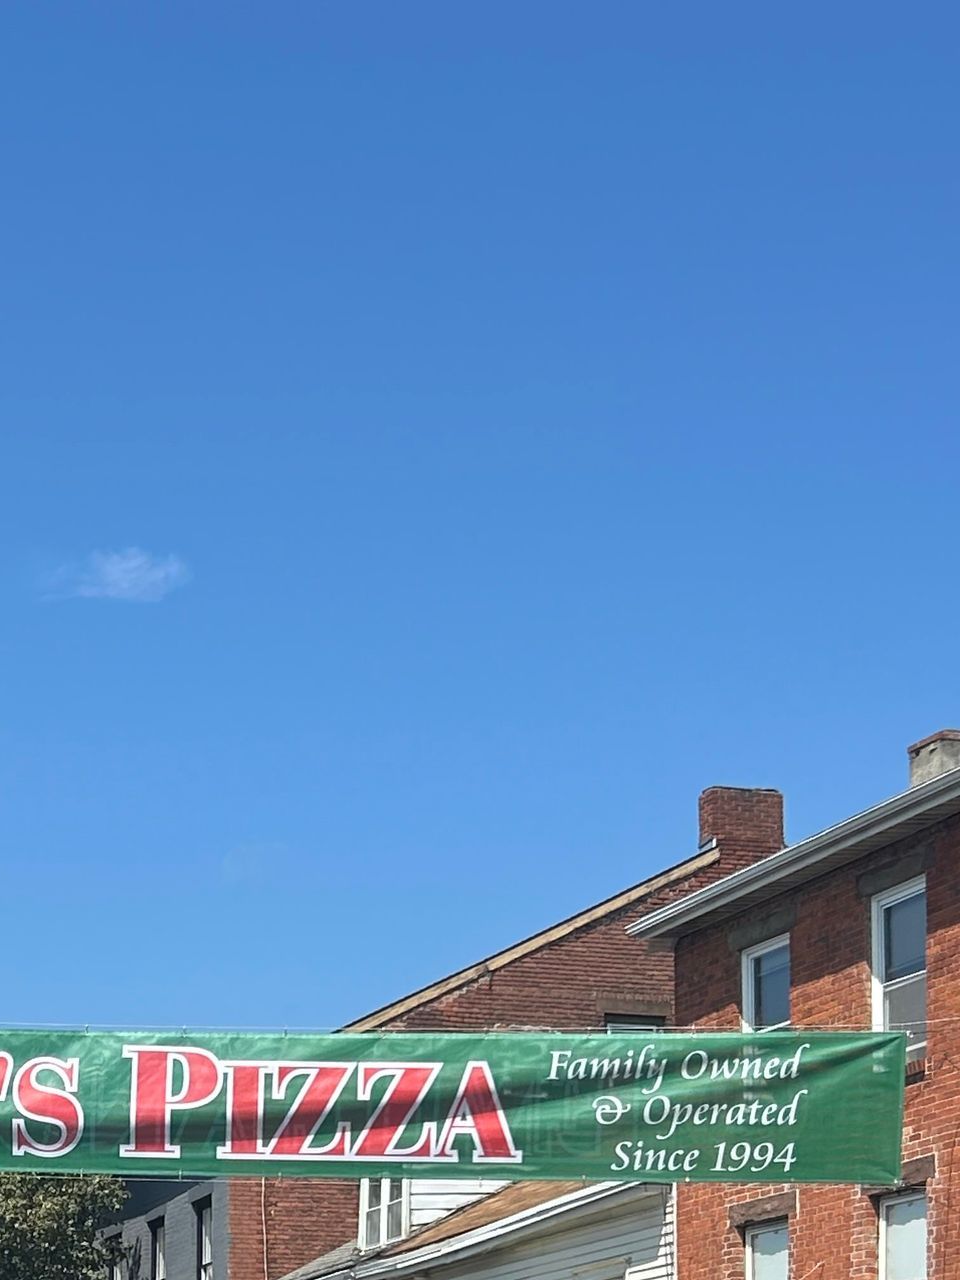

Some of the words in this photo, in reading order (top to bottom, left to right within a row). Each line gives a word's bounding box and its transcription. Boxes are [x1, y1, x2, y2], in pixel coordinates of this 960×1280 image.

[546, 1043, 668, 1094] Family
[681, 1043, 810, 1081] Owned
[120, 1043, 524, 1163] PIZZA
[592, 1095, 631, 1125] &
[642, 1089, 808, 1140] Operated
[611, 1140, 699, 1172] Since
[709, 1141, 797, 1172] 1994
